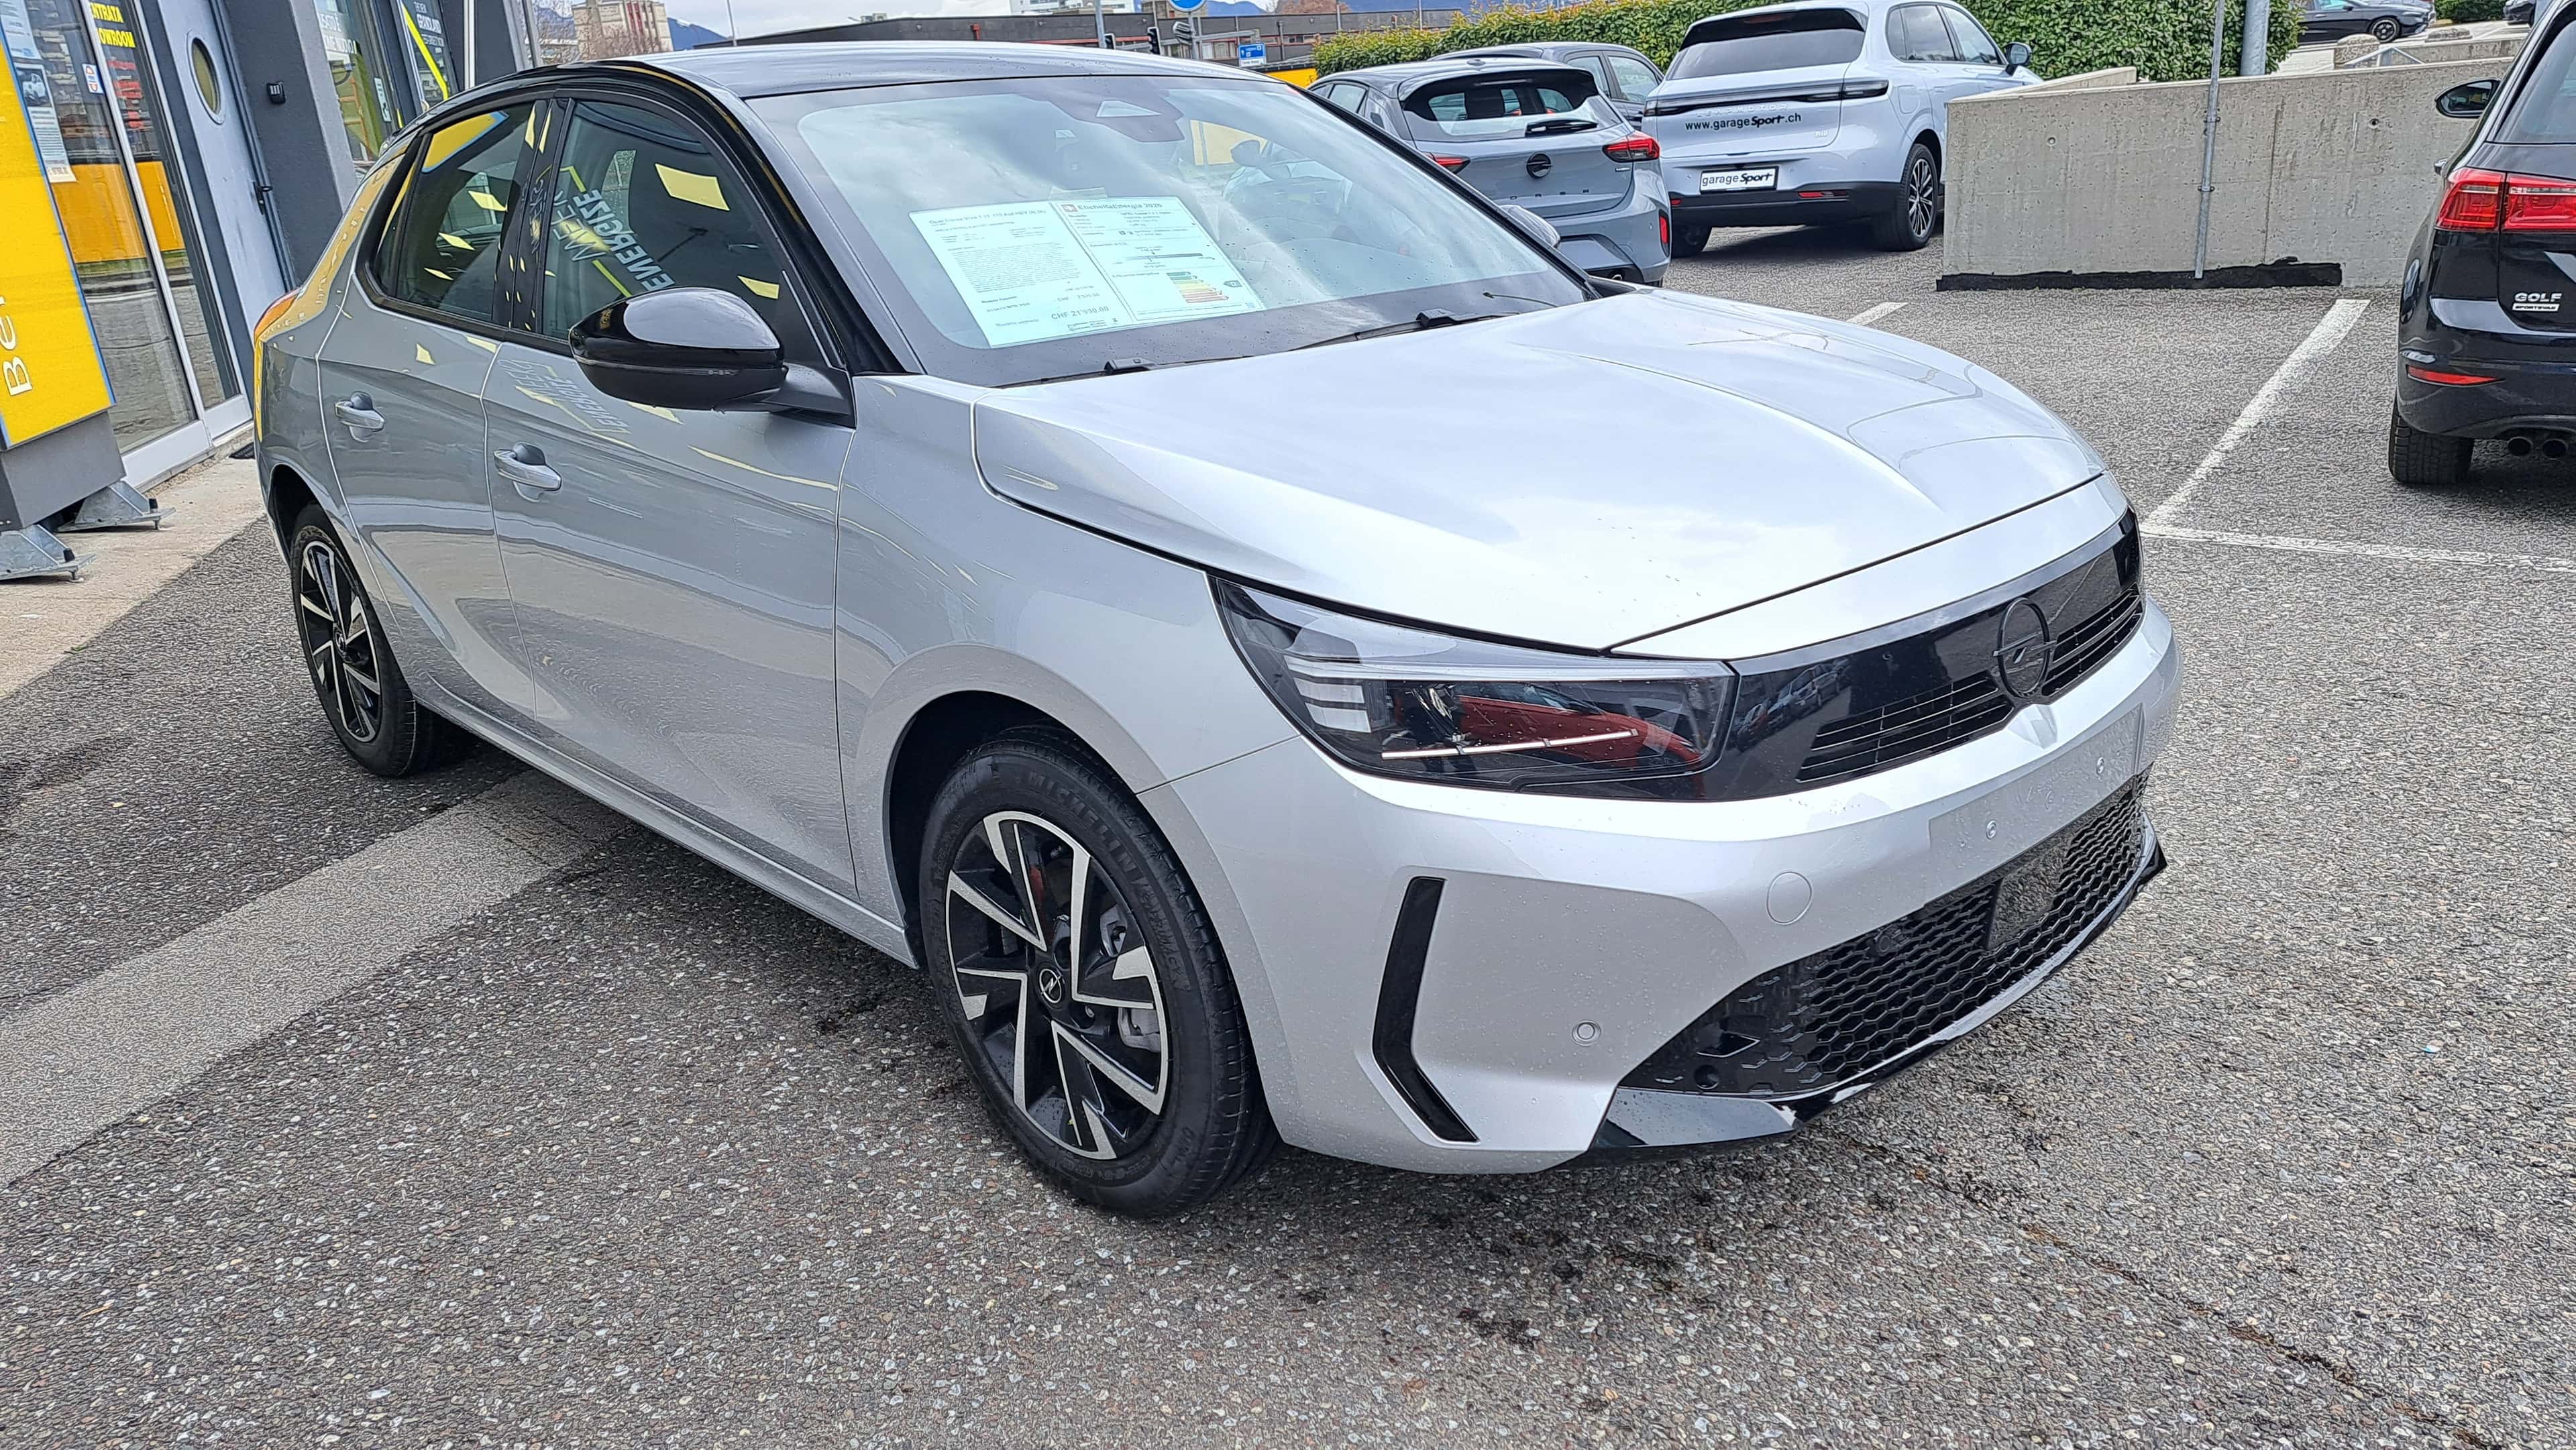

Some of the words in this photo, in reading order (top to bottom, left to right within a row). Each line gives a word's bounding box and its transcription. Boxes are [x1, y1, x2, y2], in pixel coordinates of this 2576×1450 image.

[91, 2, 124, 23] NTRATA
[97, 27, 136, 48] OWROOM
[1685, 113, 1802, 131] www.garageSport.ch
[2514, 292, 2563, 302] GOLF
[1051, 312, 1069, 320] CHF
[0, 296, 33, 396] Be
